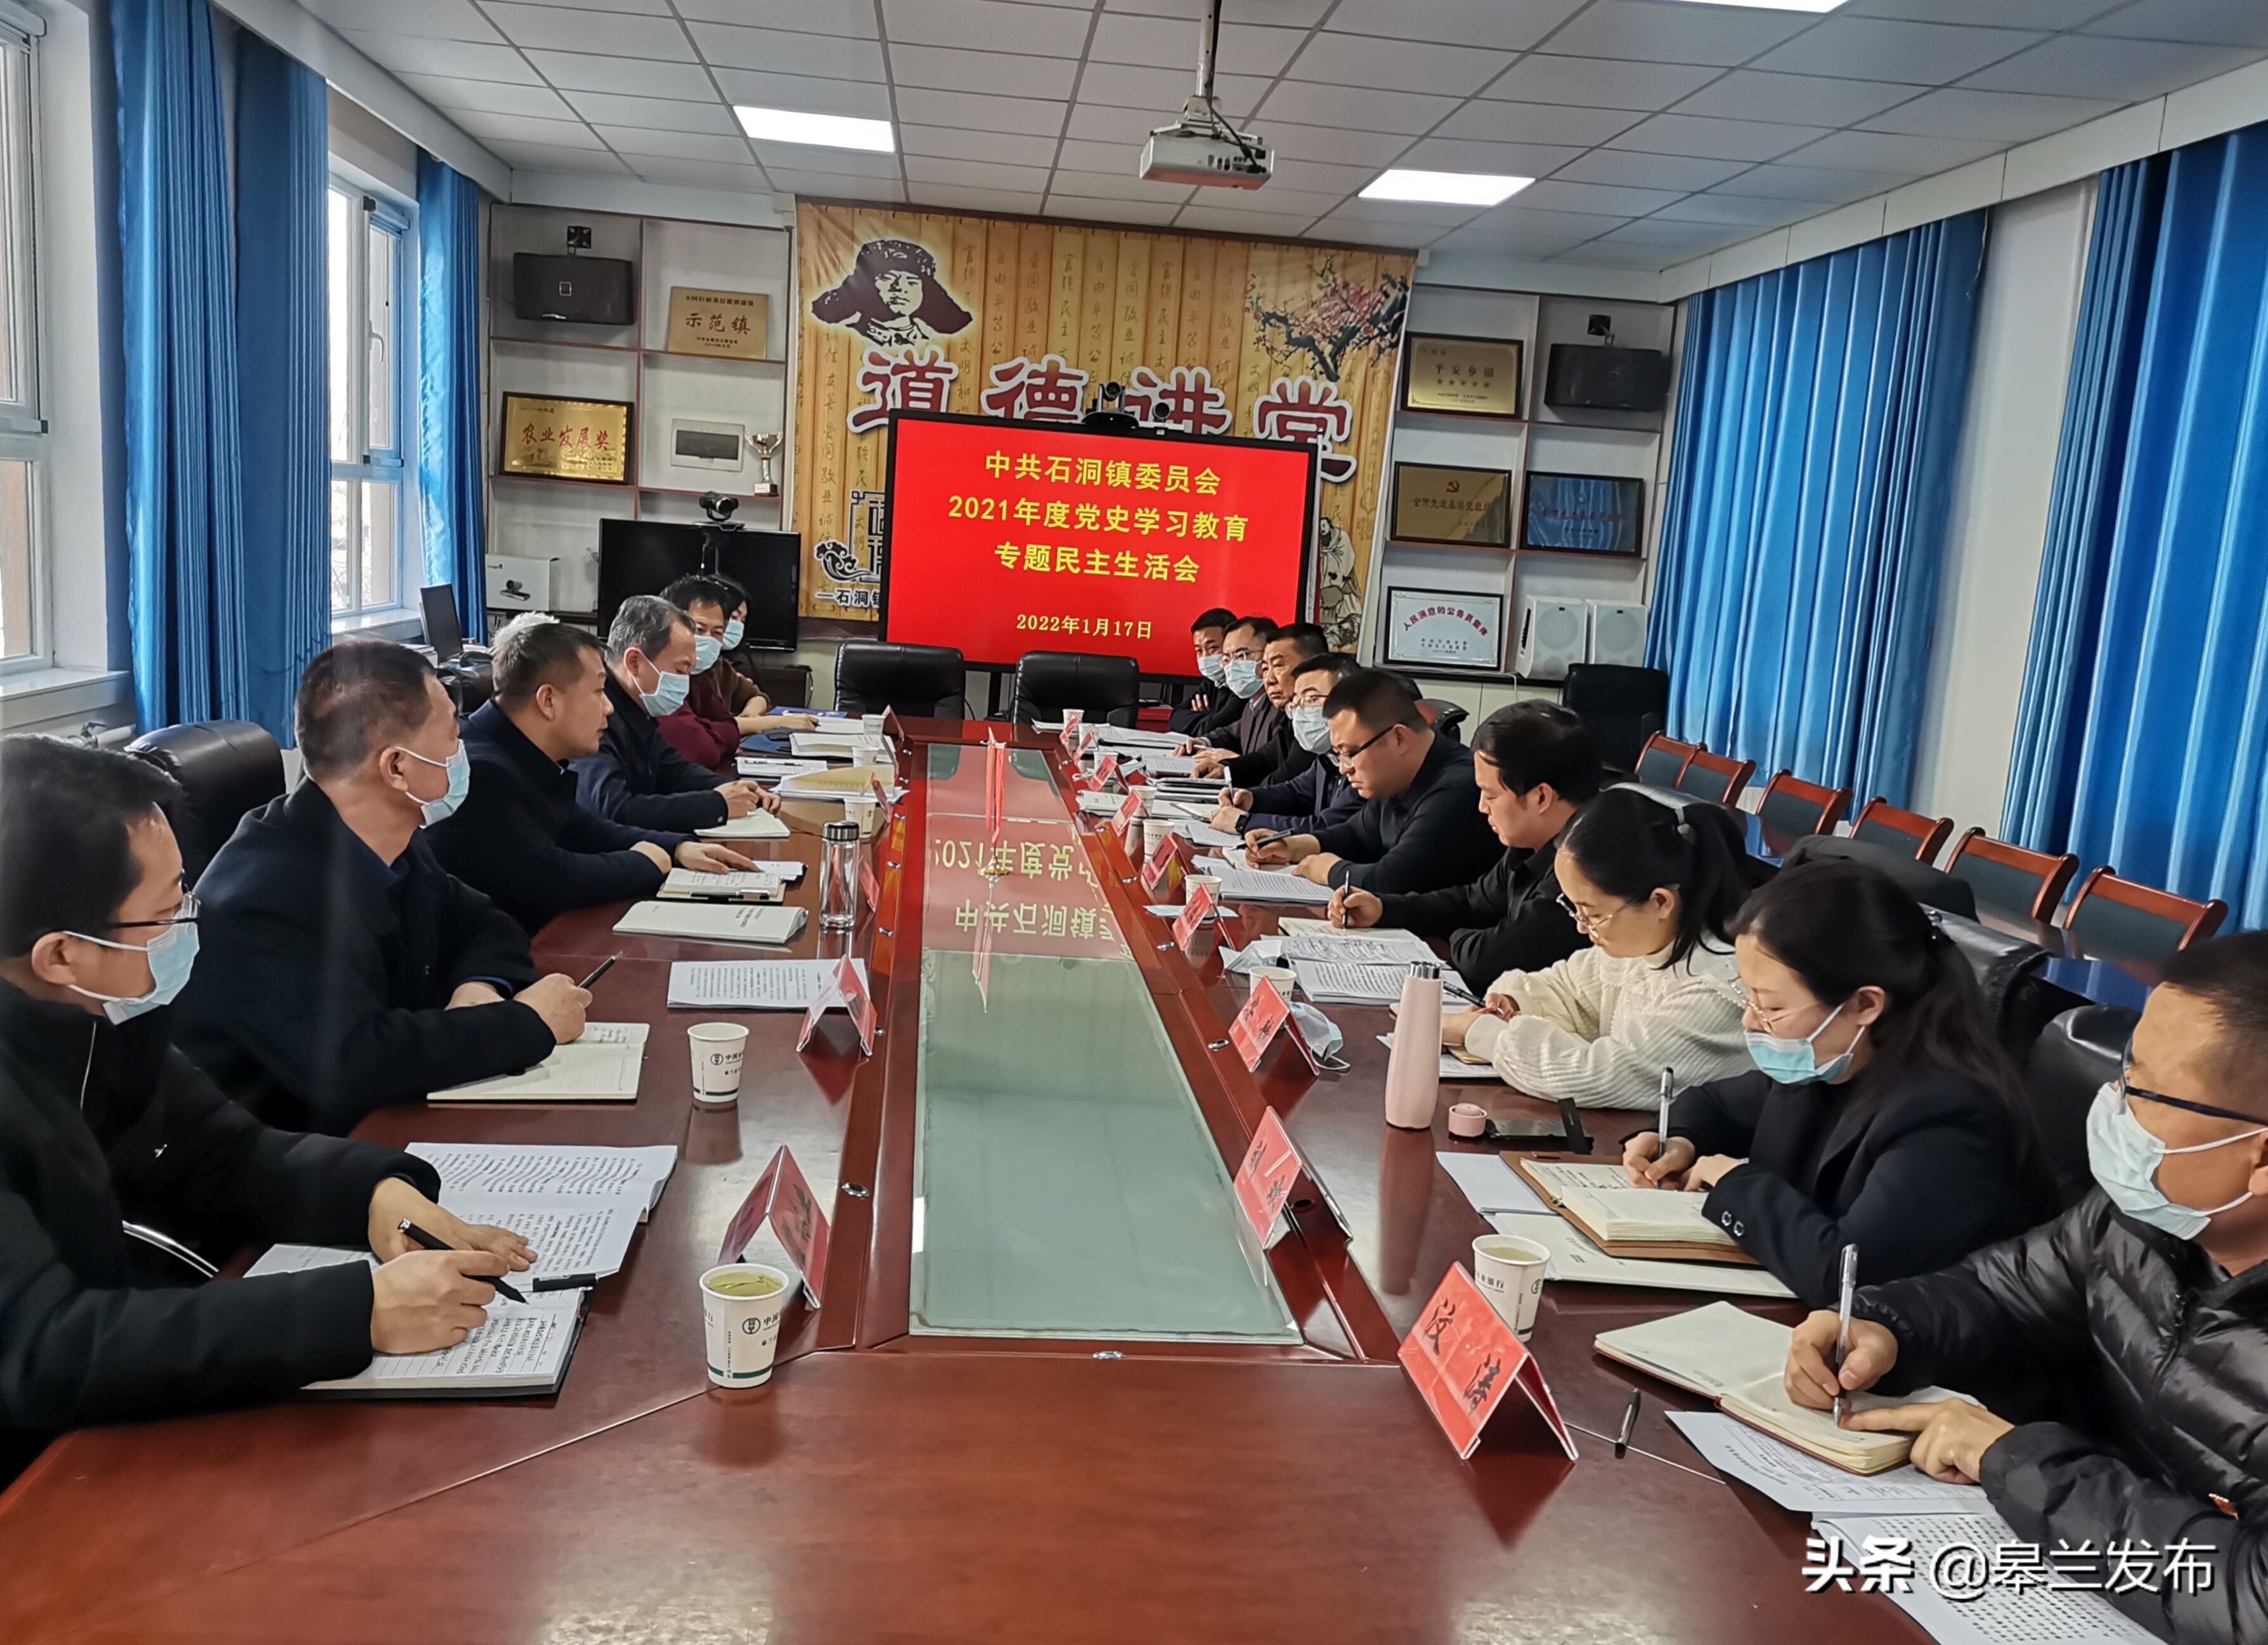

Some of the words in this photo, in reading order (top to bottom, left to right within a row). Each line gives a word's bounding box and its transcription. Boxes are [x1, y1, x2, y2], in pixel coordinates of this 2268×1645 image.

[685, 313, 751, 335] 示范镇
[521, 422, 610, 451] 农业发展奖
[987, 451, 1220, 495] 中共石洞镇委员会
[949, 496, 1248, 541] 2021年度党史学习教育
[995, 542, 1199, 582] 专题民主生活会
[1017, 614, 1151, 639] 2022年1月17日
